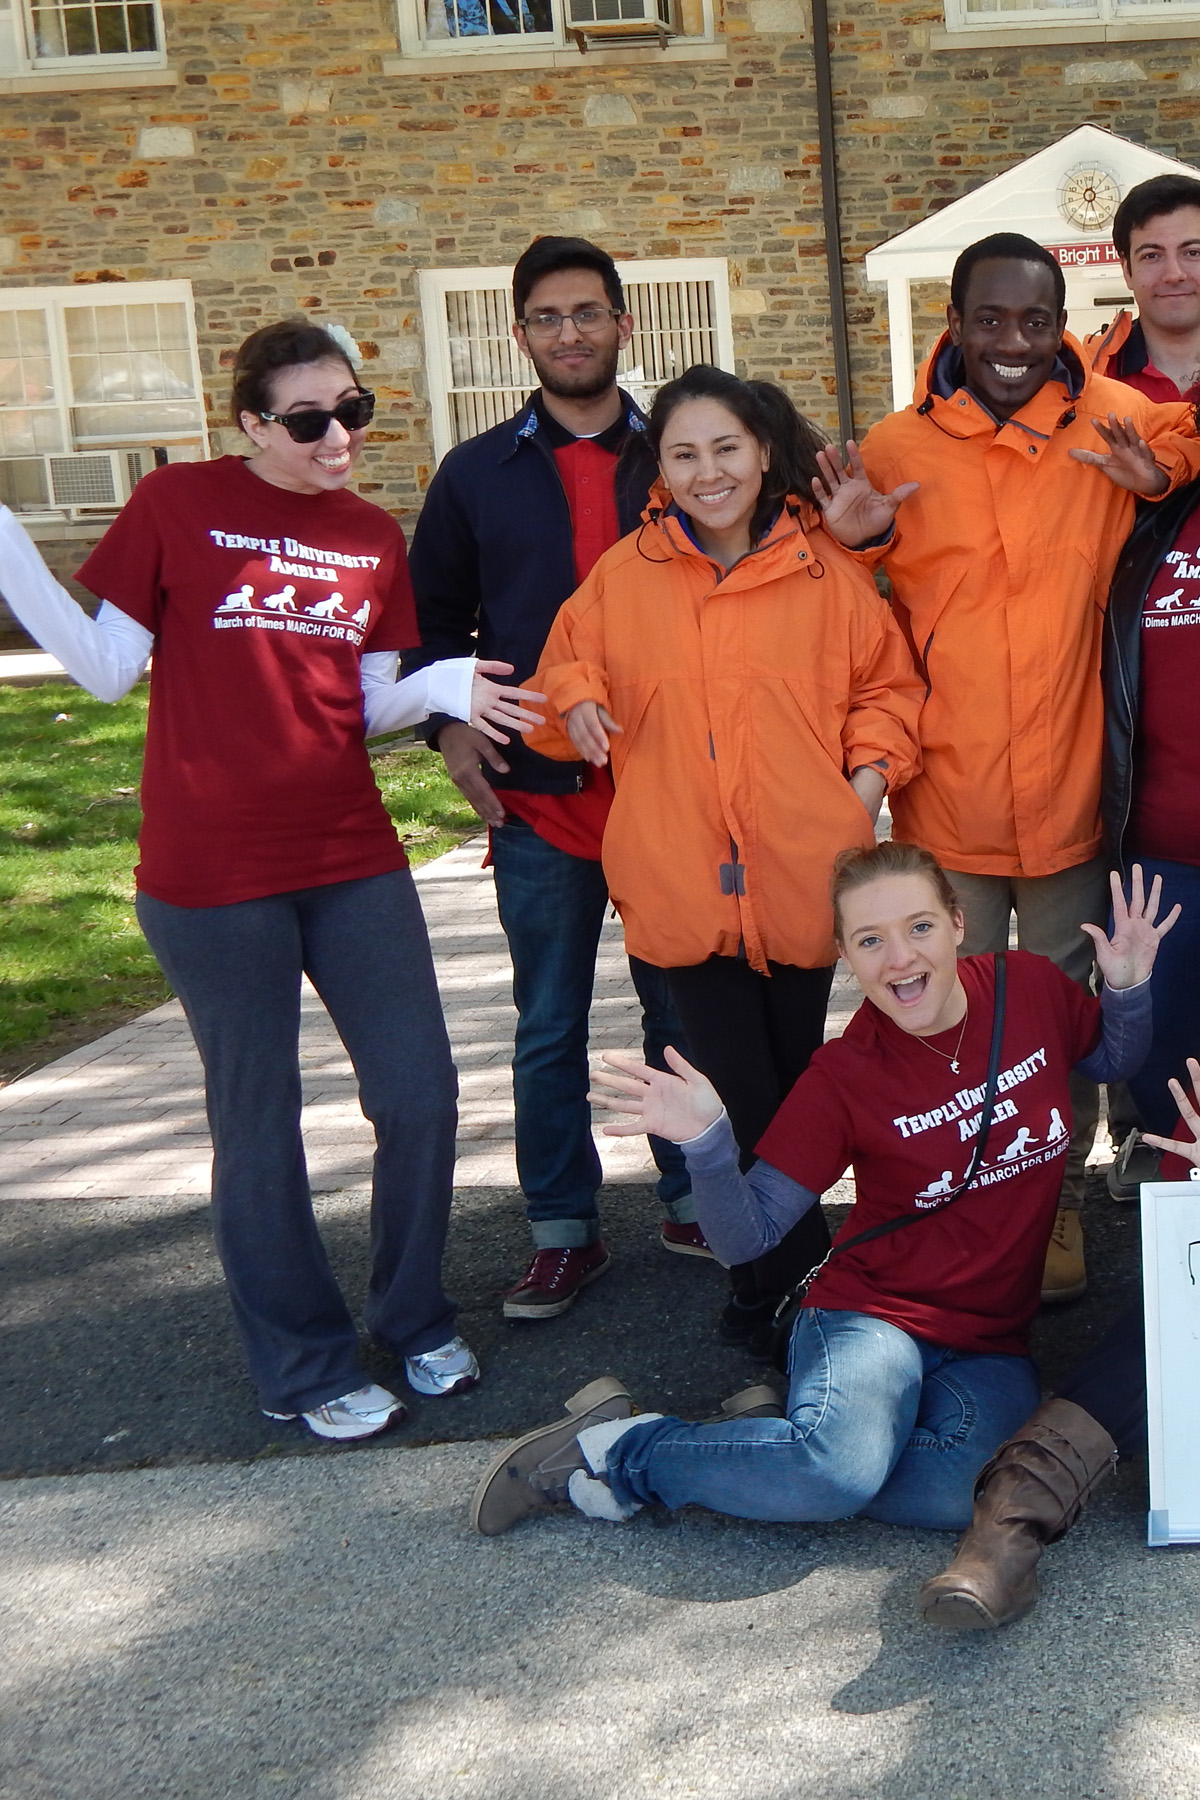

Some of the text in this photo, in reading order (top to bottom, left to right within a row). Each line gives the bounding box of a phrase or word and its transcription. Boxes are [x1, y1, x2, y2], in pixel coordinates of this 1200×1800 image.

[1058, 246, 1101, 265] Bright
[209, 530, 381, 571] TEMPLE UNIVERSITY
[269, 555, 339, 583] AMBLER
[214, 616, 243, 629] March
[245, 616, 256, 628] of
[256, 616, 285, 630] Dimes
[286, 619, 322, 637] MARCH
[322, 626, 344, 641] FOR
[1145, 617, 1170, 628] Dimes
[893, 1047, 1048, 1139] TEMPLE UNIERSITY
[980, 1164, 1020, 1187] MARCH
[1021, 1155, 1043, 1173] FOR
